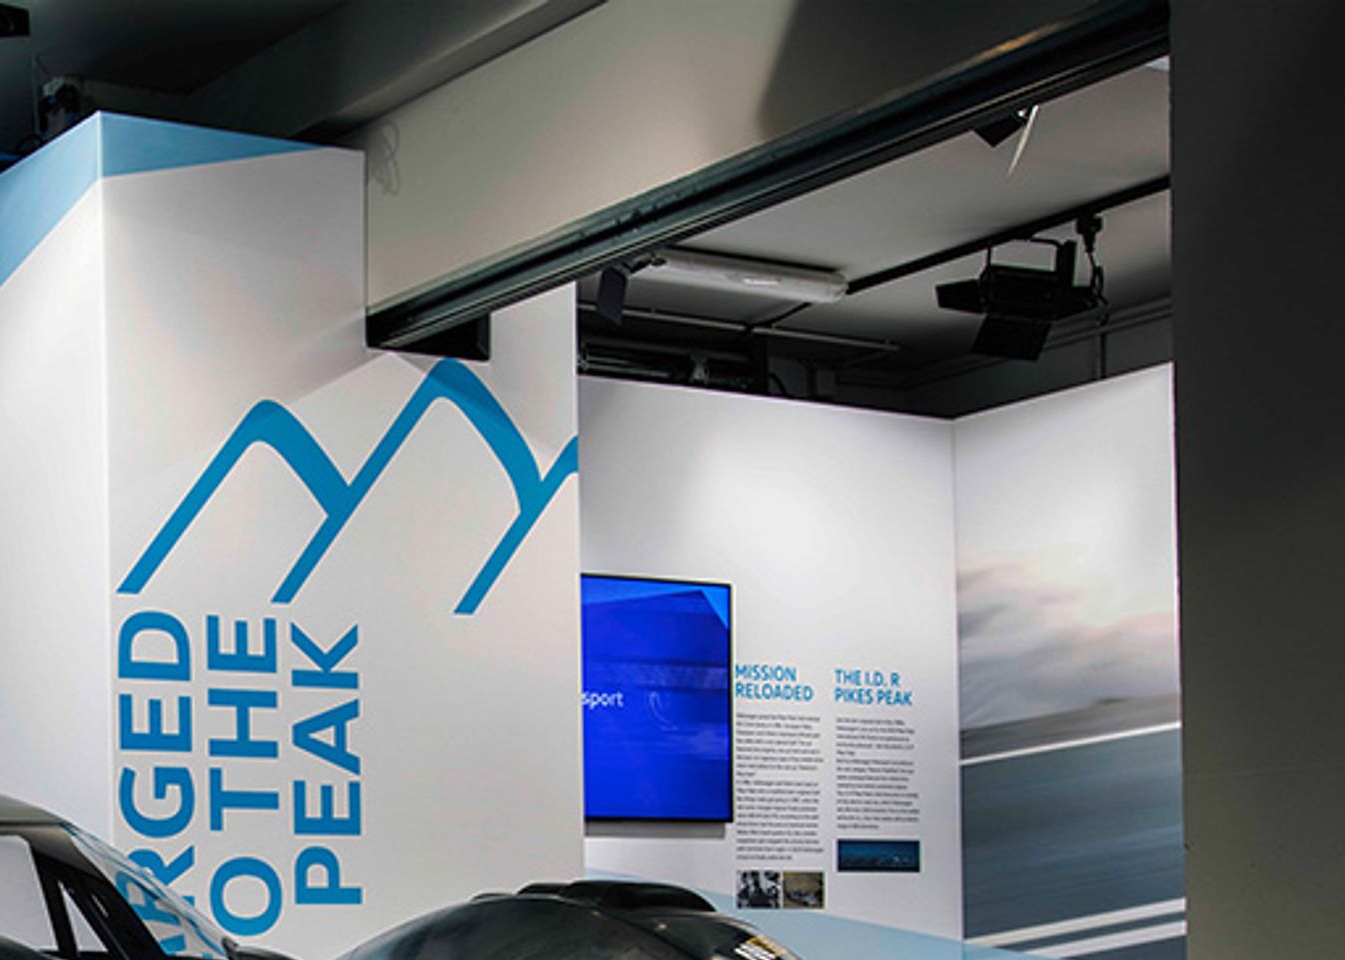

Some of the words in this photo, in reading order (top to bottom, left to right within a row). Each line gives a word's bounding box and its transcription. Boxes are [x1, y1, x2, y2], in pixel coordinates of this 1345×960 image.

[734, 664, 797, 682] MISSION
[834, 668, 862, 686] THE
[890, 672, 901, 687] R
[735, 682, 815, 702] RELOADED
[834, 688, 873, 706] PIKES
[876, 690, 913, 706] PEAK
[206, 614, 280, 832] THE
[289, 622, 363, 905] PEAK
